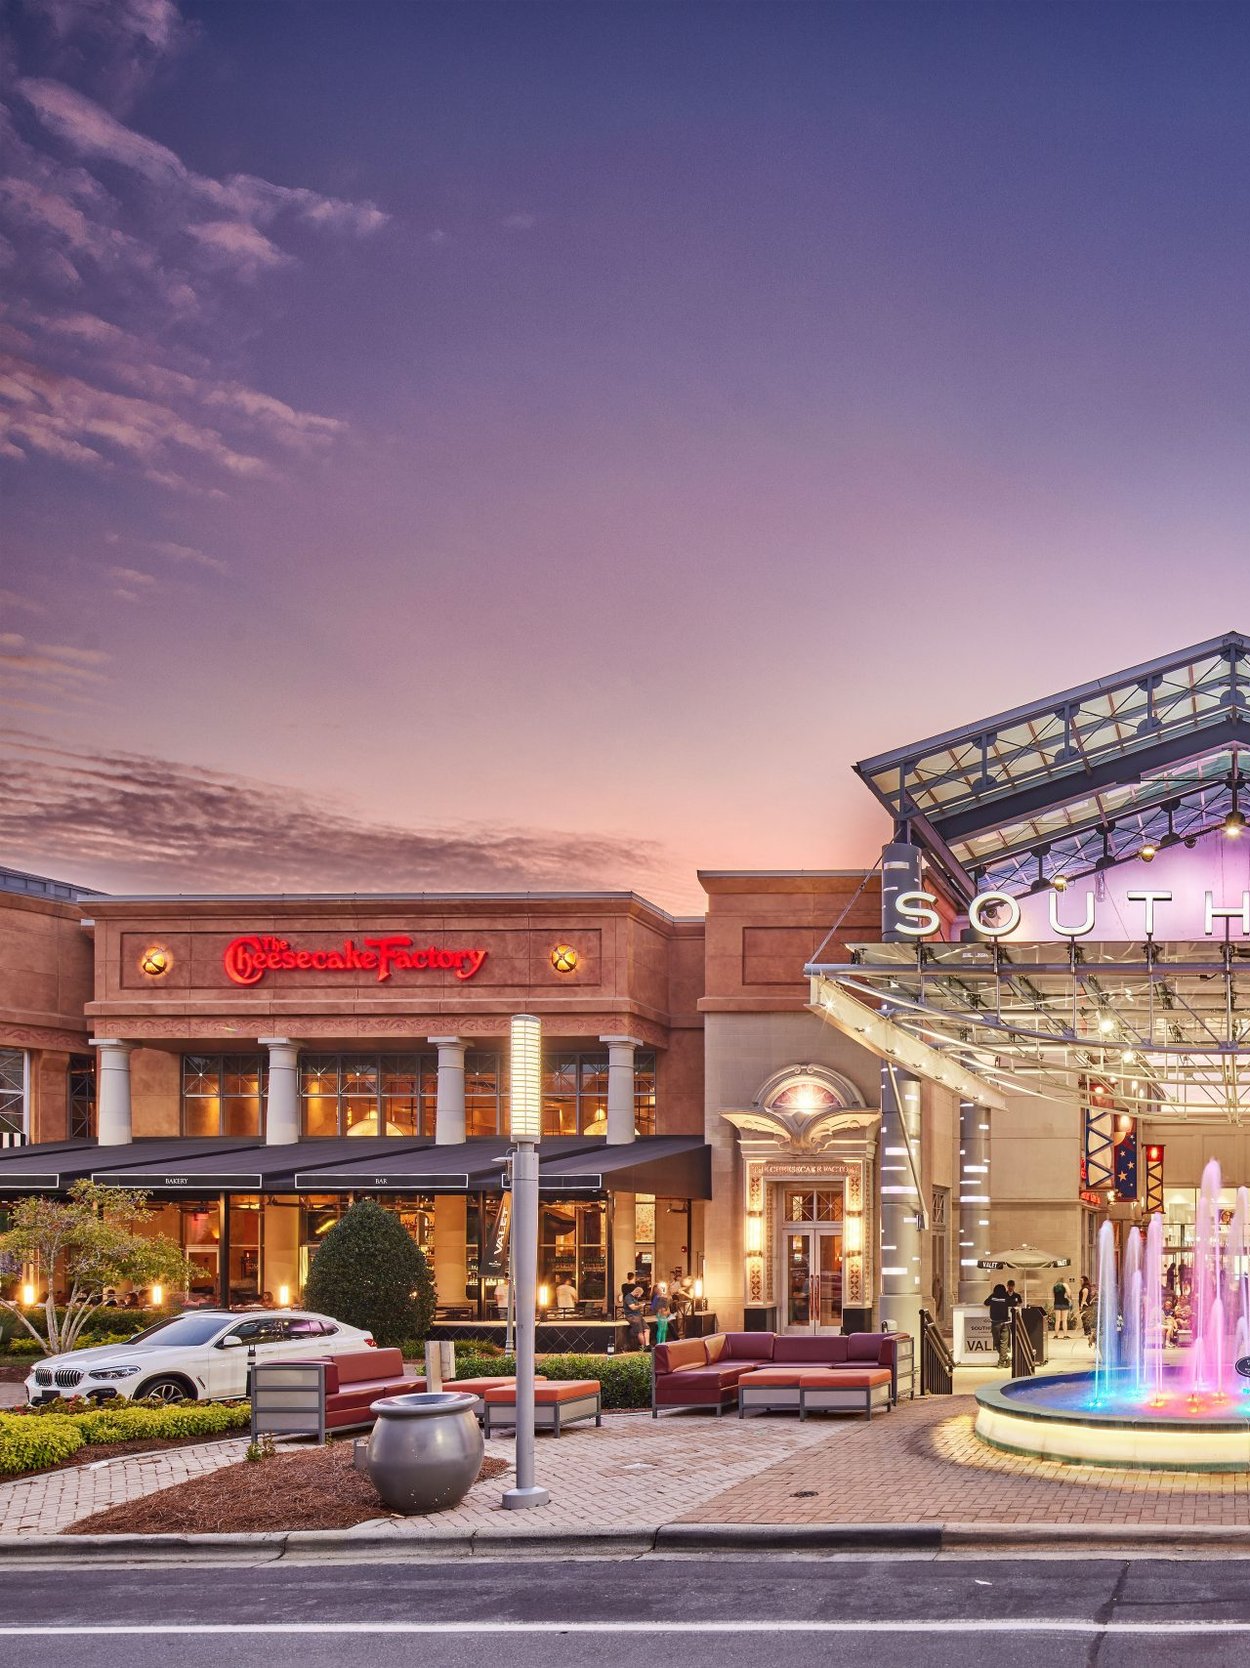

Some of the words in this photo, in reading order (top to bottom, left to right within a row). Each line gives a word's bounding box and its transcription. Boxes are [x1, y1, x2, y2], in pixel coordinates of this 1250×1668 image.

[262, 935, 289, 950] The
[224, 936, 378, 985] Cheesecake
[364, 936, 488, 982] Factory
[494, 1206, 508, 1255] VALET
[982, 1261, 998, 1269] VALET
